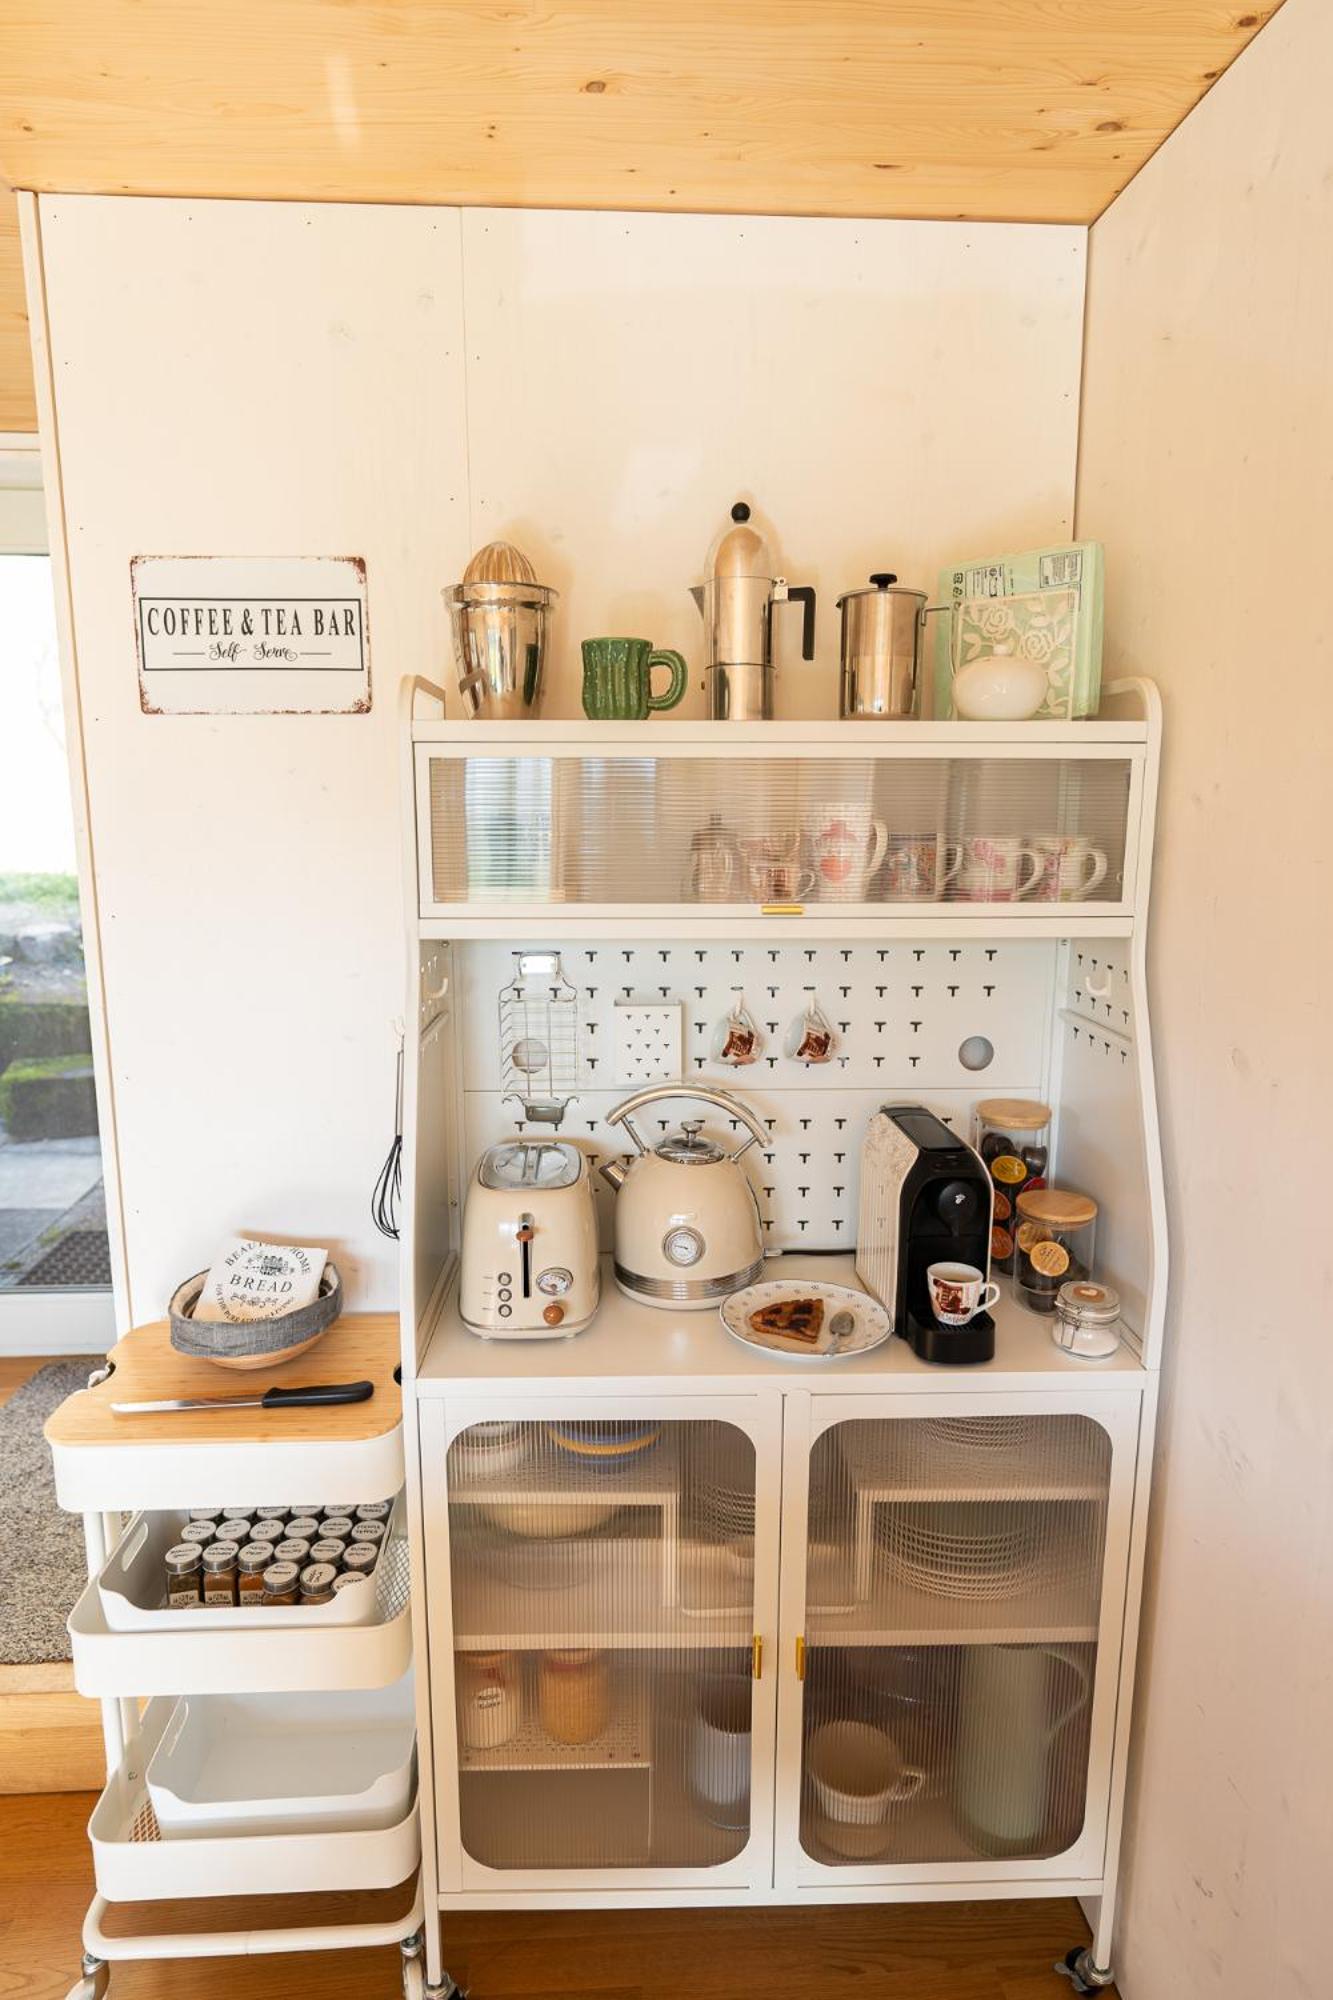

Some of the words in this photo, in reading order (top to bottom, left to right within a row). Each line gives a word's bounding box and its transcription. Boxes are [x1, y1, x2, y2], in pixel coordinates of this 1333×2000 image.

[147, 607, 233, 636] COFFEE
[241, 607, 254, 637] &
[261, 608, 302, 636] TEA
[313, 608, 356, 636] BAR
[209, 640, 248, 663] Self
[253, 641, 298, 662] Serve
[289, 1247, 312, 1275] HOME
[230, 1274, 293, 1293] BREAD
